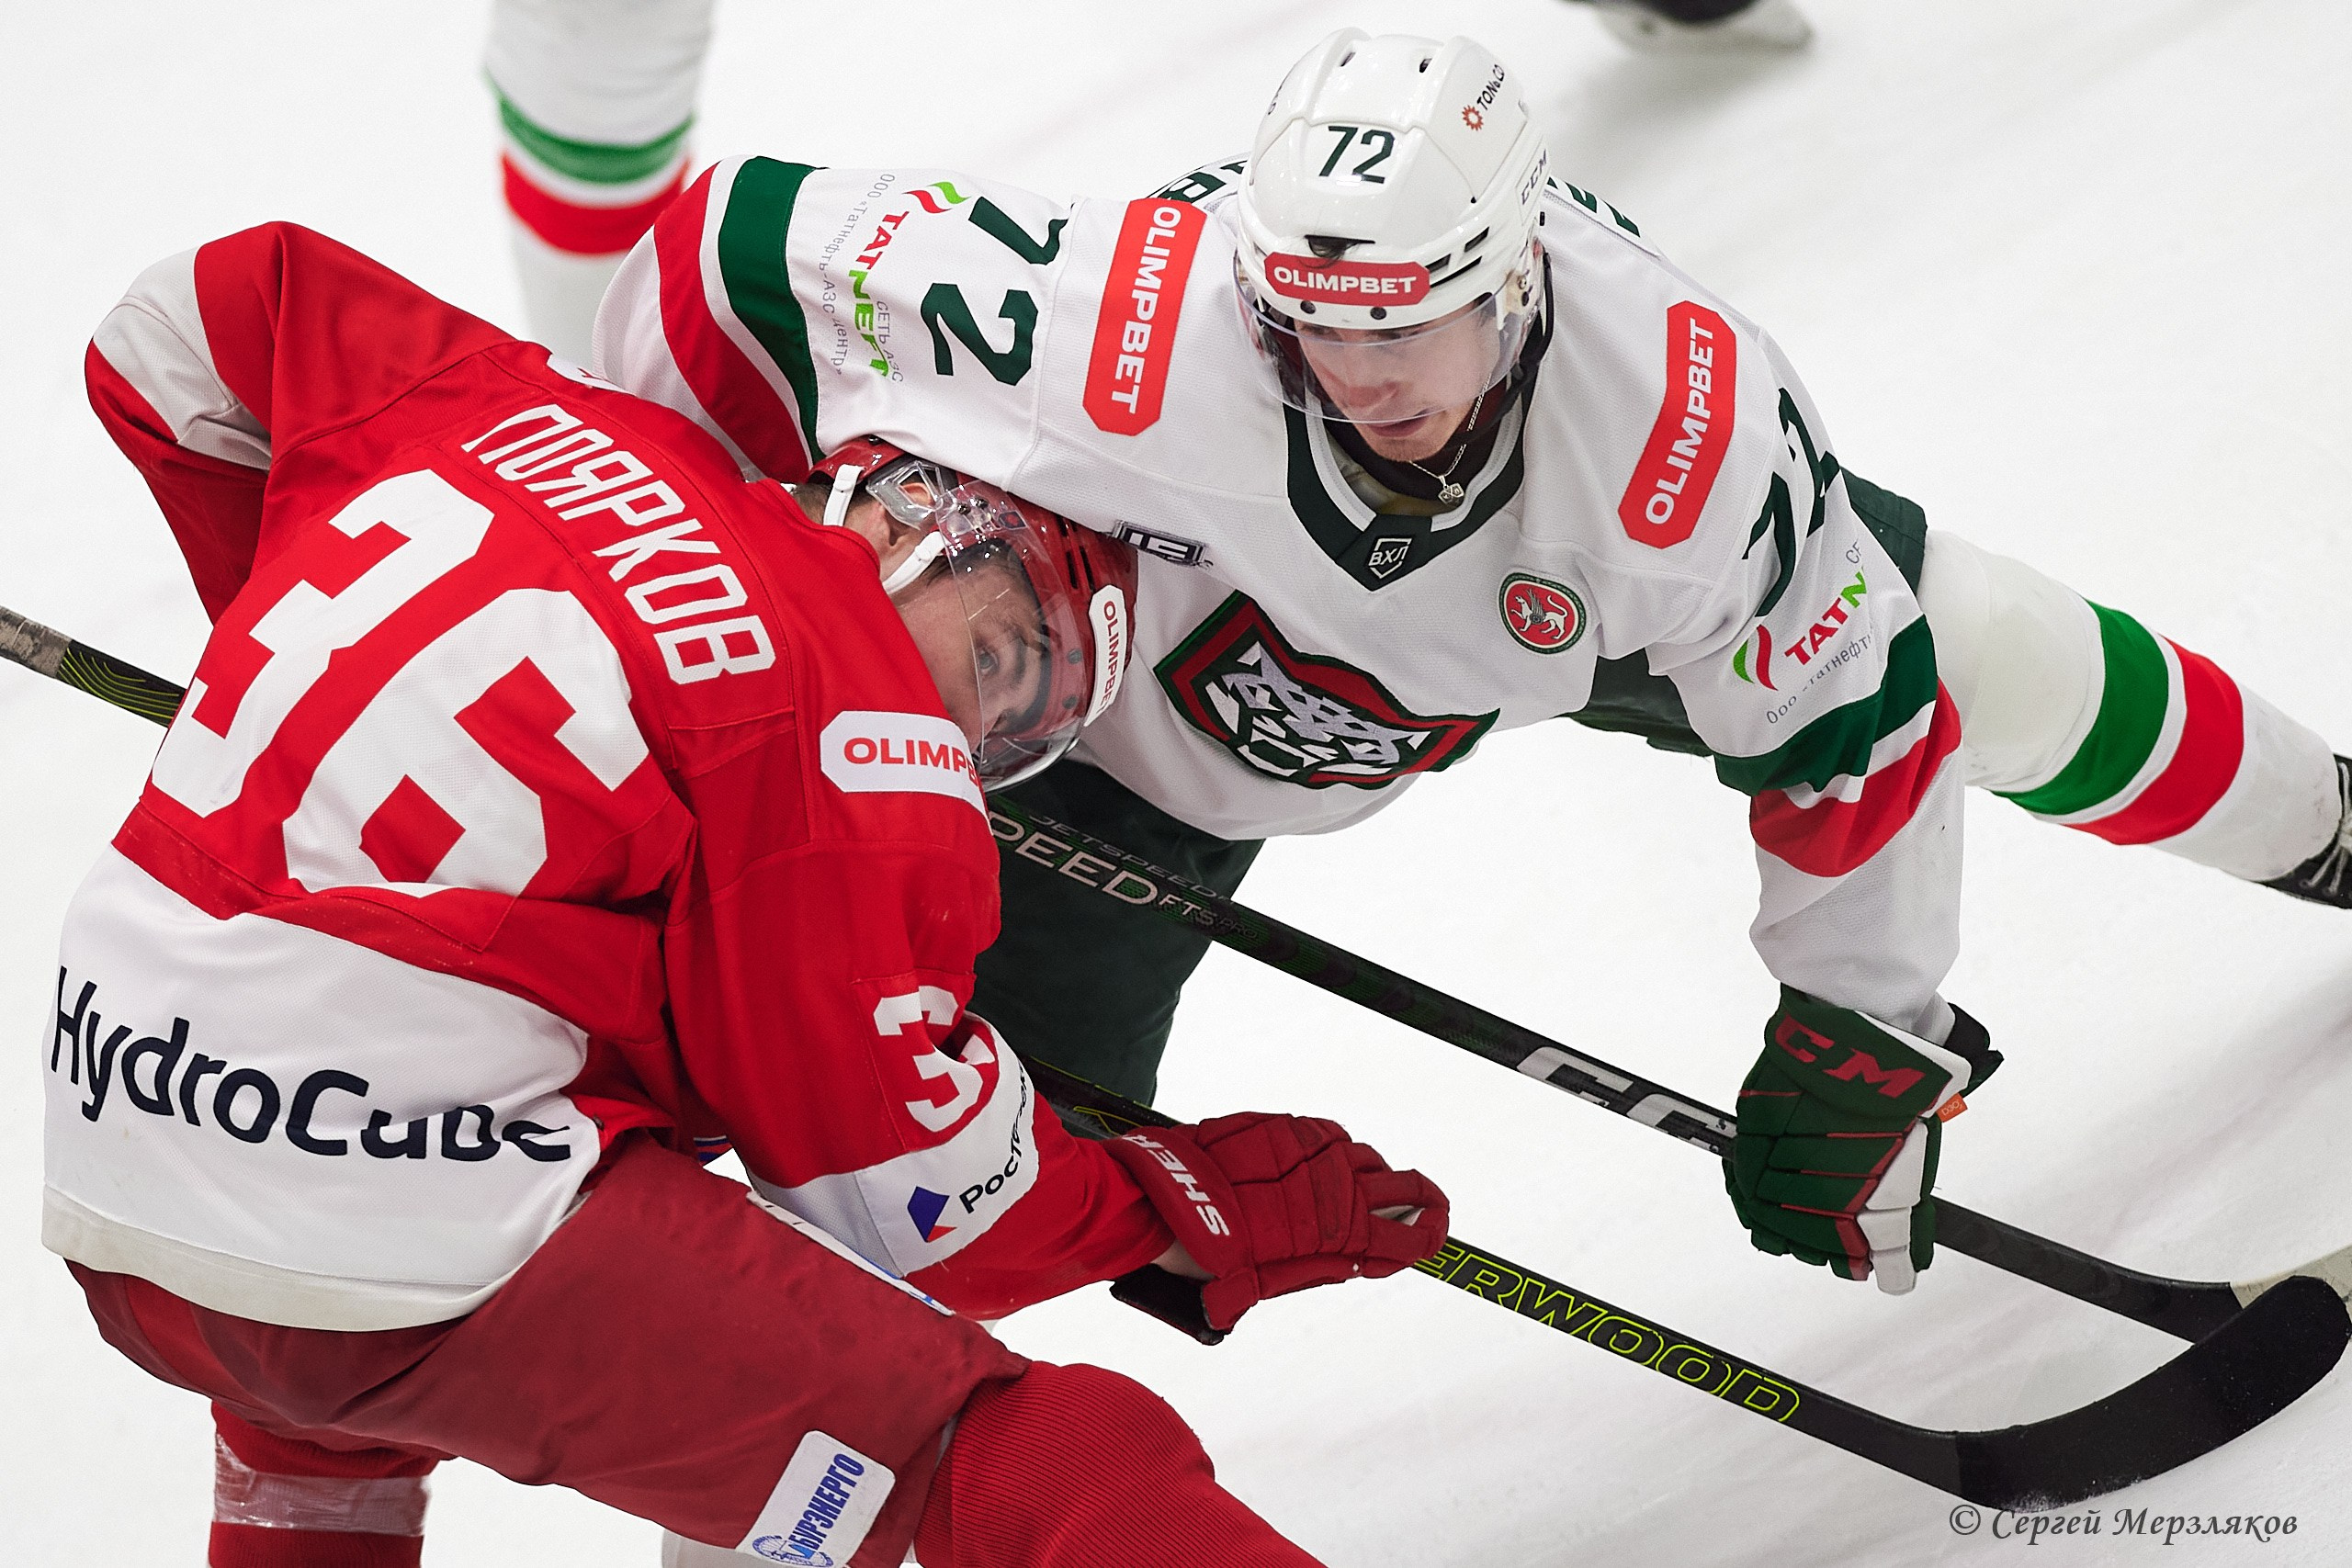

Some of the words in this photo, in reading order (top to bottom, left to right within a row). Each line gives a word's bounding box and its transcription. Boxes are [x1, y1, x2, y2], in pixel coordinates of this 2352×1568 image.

[1318, 125, 1396, 184] 72
[920, 196, 1070, 386] 72
[1111, 206, 1182, 414] OLIMPBET
[1273, 265, 1418, 295] OLIMPBET
[1645, 317, 1715, 525] OLIMPBET
[461, 403, 775, 685] ПОЯРКОВ
[1368, 546, 1408, 566] ВХЛ
[152, 468, 650, 899] 36
[1029, 815, 1218, 898] JETSPEED
